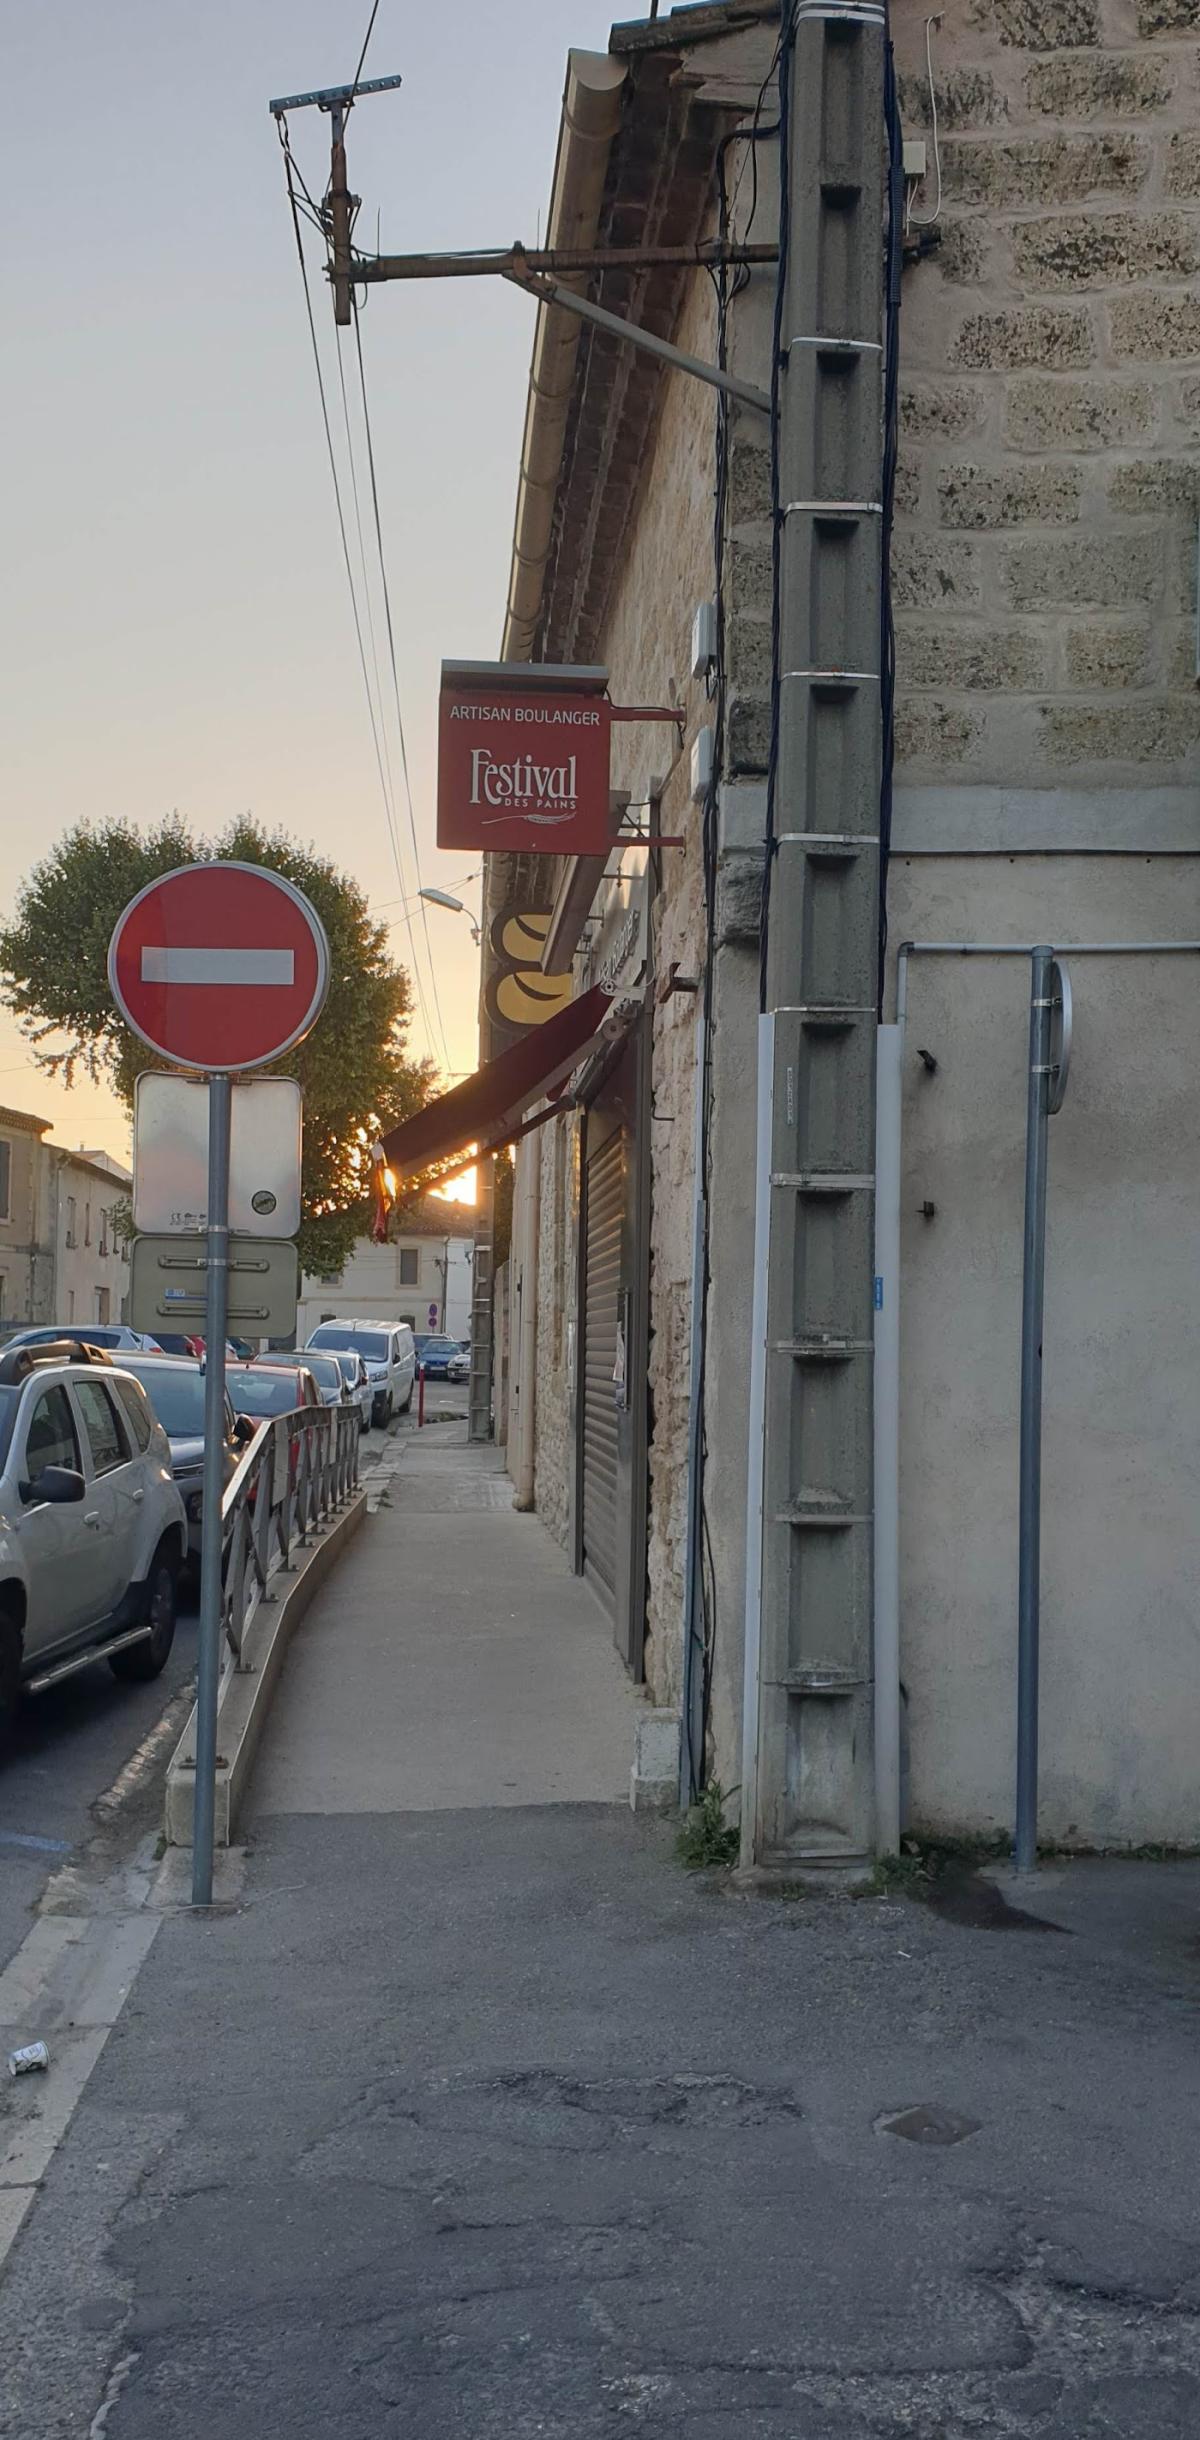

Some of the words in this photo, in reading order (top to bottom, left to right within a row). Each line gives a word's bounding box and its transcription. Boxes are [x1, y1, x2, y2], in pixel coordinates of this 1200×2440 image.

[450, 705, 511, 721] ARTISAN
[514, 708, 600, 726] BOULANGER
[468, 748, 579, 805] Festival
[504, 799, 529, 808] DES
[536, 799, 577, 810] PAINS
